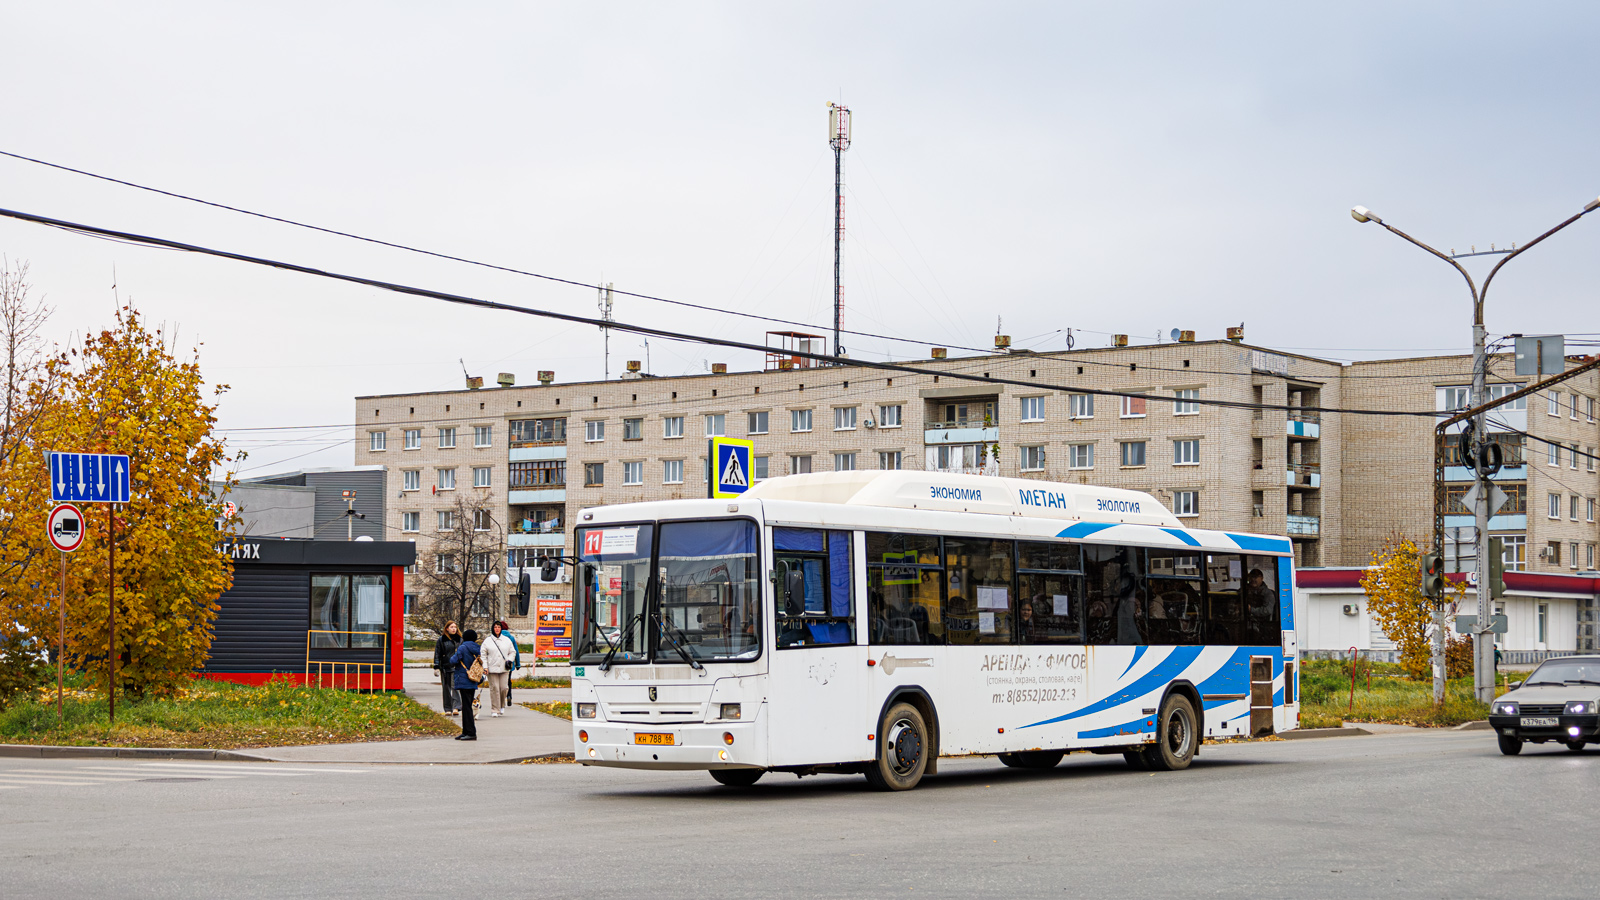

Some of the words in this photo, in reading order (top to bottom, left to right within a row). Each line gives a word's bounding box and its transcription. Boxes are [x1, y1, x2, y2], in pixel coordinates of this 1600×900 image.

[930, 486, 982, 501] ЭКОНОМИЯ
[1019, 489, 1067, 509] МЕТАН
[1097, 499, 1141, 514] ЭКОЛОГИЯ
[587, 534, 600, 551] 11
